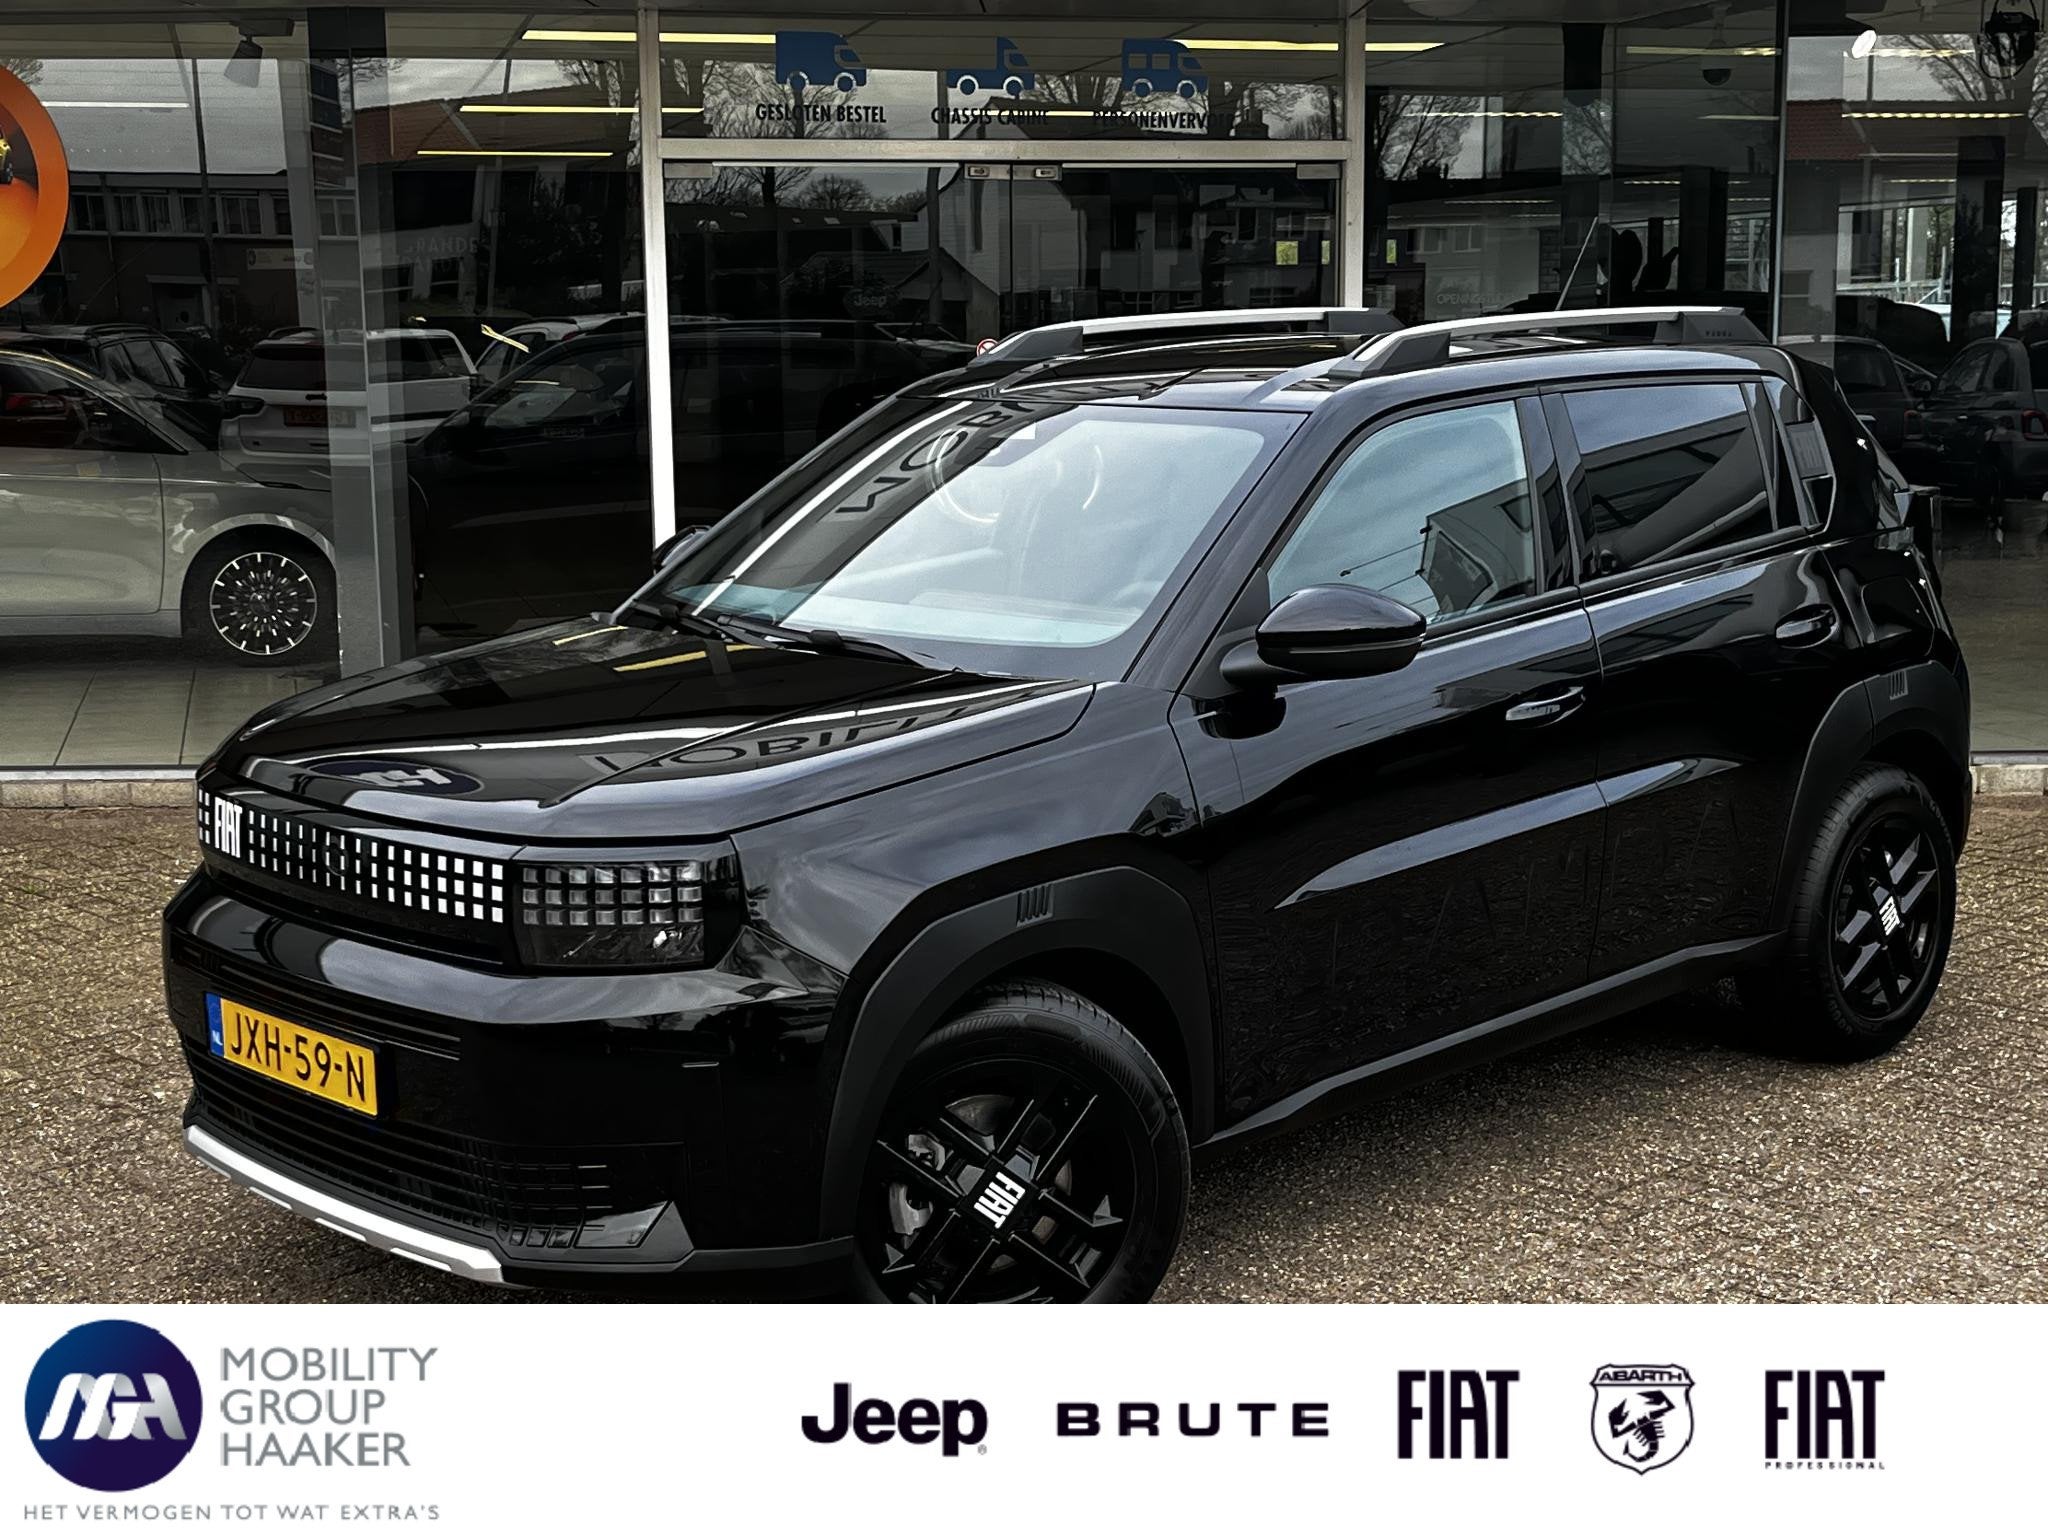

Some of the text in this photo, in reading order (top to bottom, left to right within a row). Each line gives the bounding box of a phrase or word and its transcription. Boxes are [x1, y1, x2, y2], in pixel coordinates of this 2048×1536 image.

[756, 104, 887, 123] GESLOTEN BESTEL
[931, 106, 992, 125] CHASSIS
[214, 796, 243, 858] FIAT
[1879, 895, 1900, 936] FIAT
[231, 1012, 366, 1103] JXH-59-N
[973, 1171, 1026, 1229] FIAT
